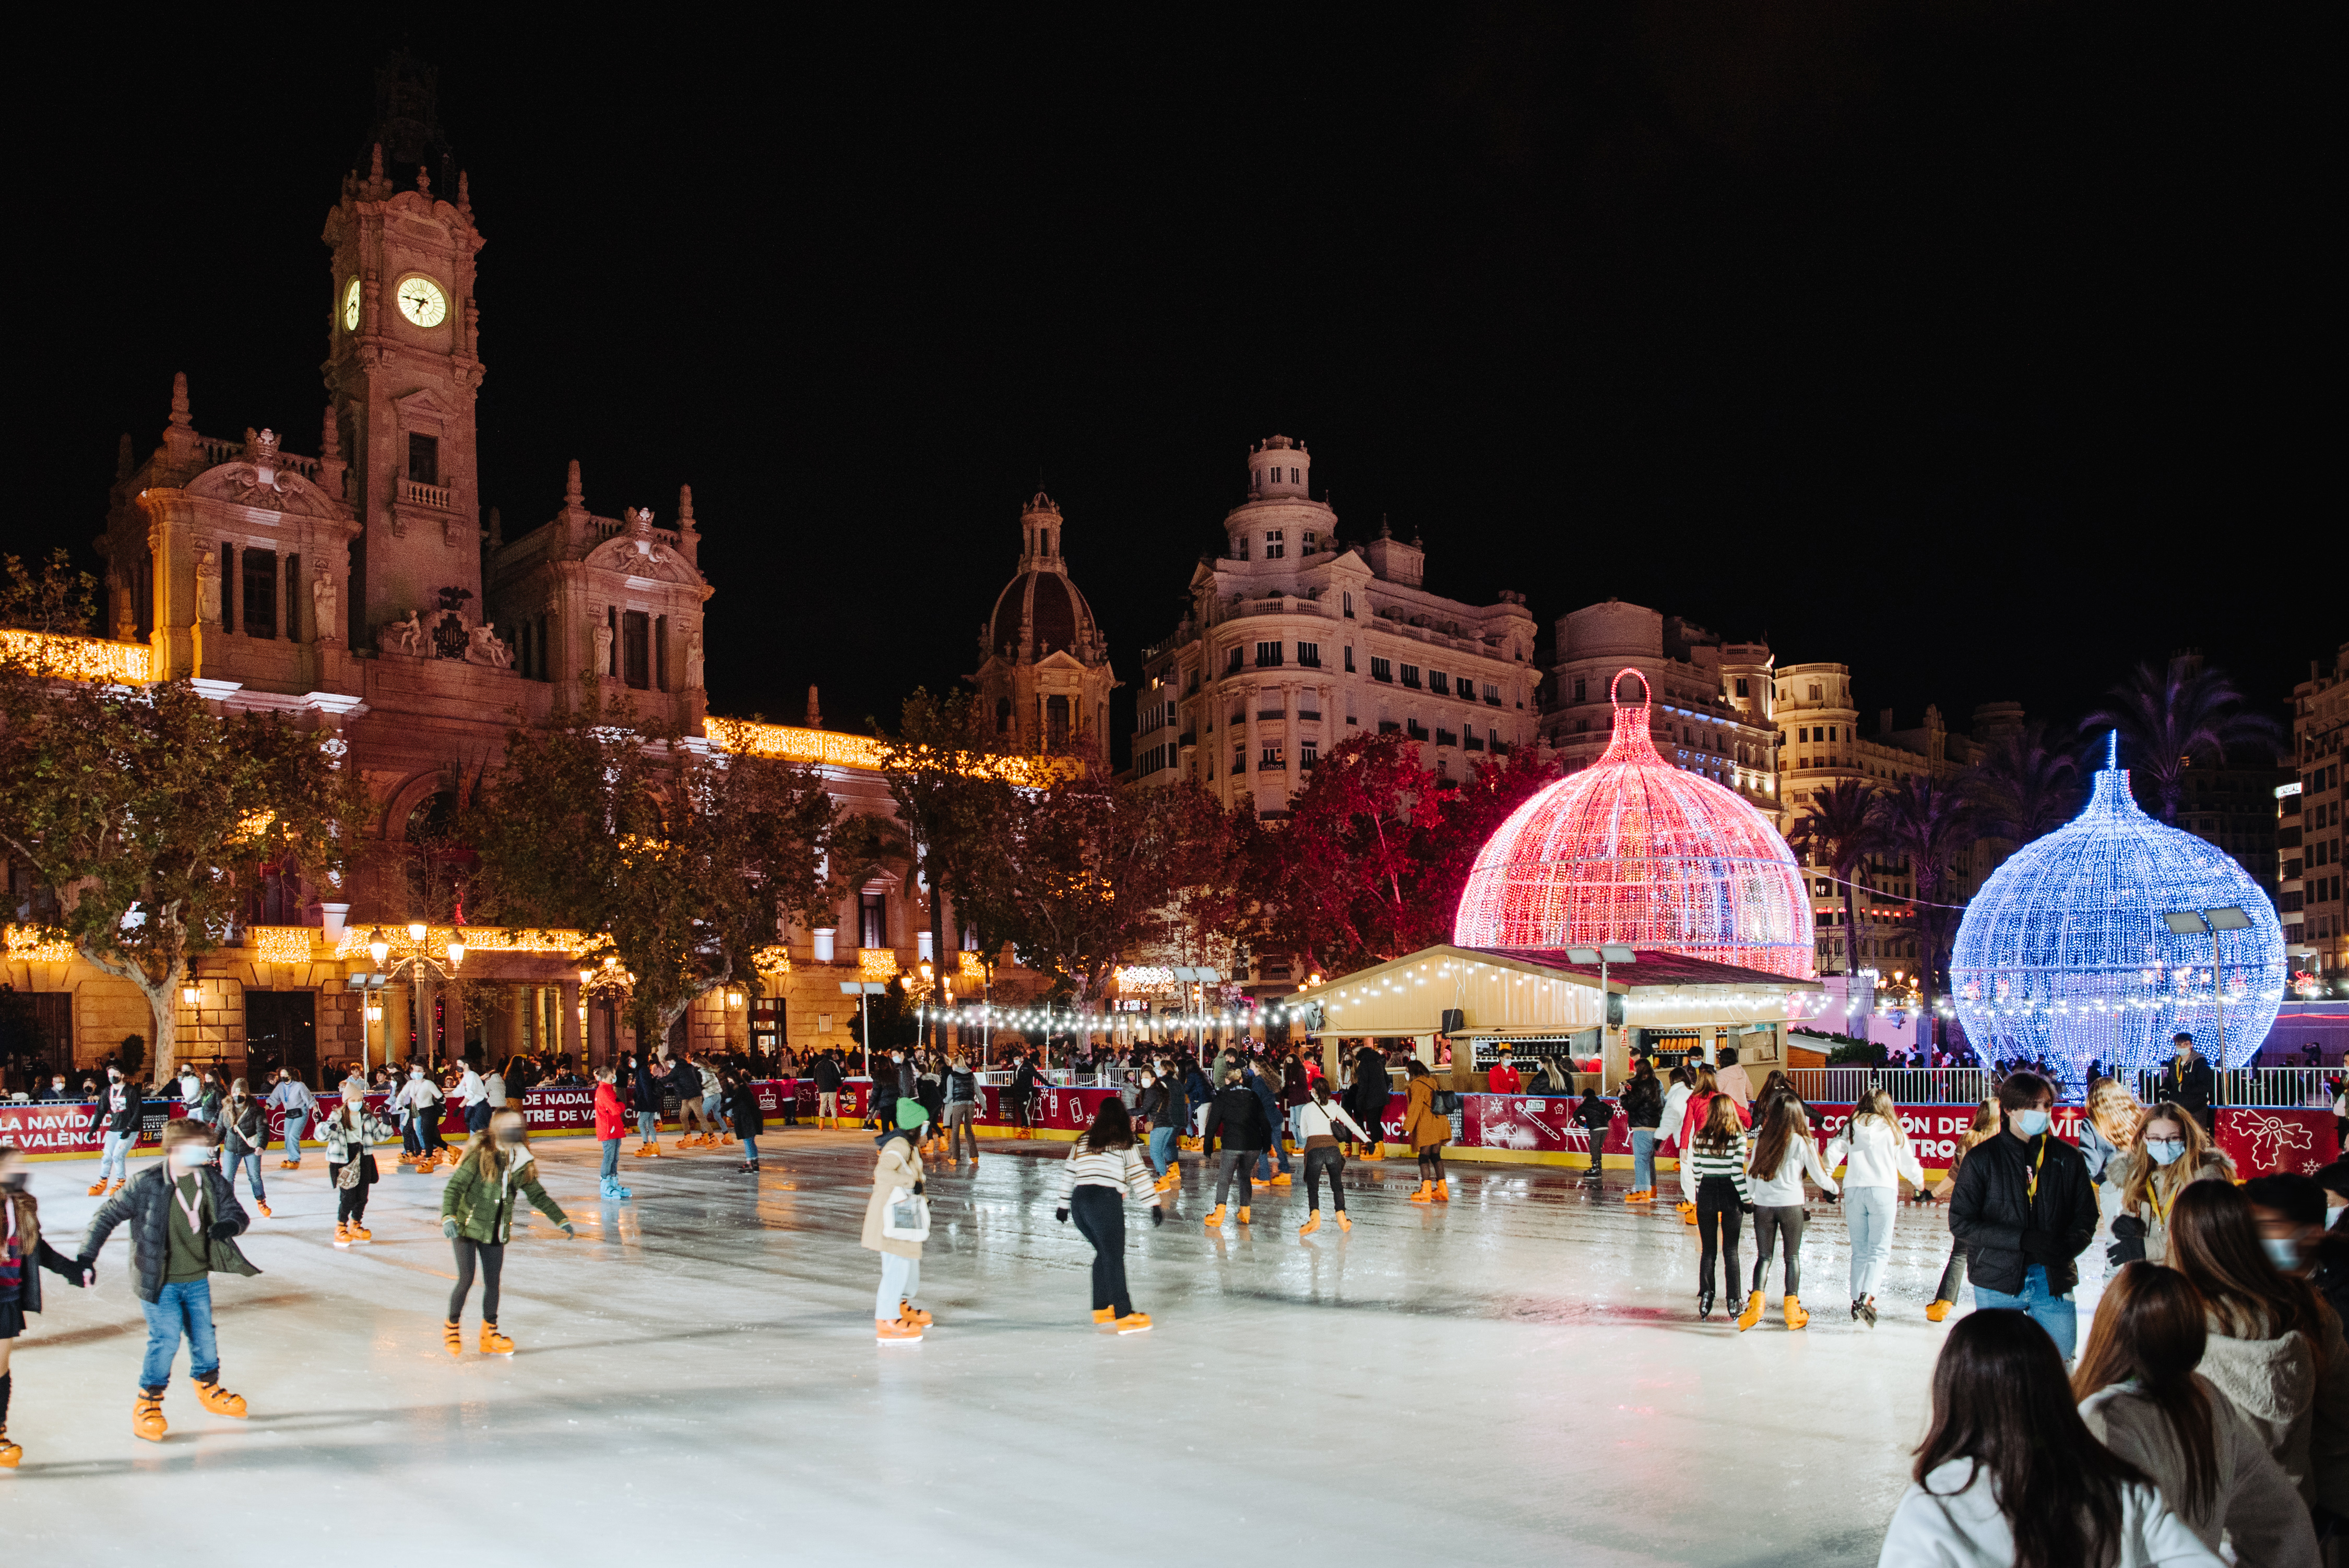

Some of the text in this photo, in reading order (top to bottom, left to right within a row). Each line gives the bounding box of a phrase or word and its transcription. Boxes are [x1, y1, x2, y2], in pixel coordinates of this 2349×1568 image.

[523, 1093, 592, 1106] DE NADAL
[559, 1110, 578, 1121] DE
[1938, 1117, 1969, 1134] DE
[143, 1132, 152, 1140] 28
